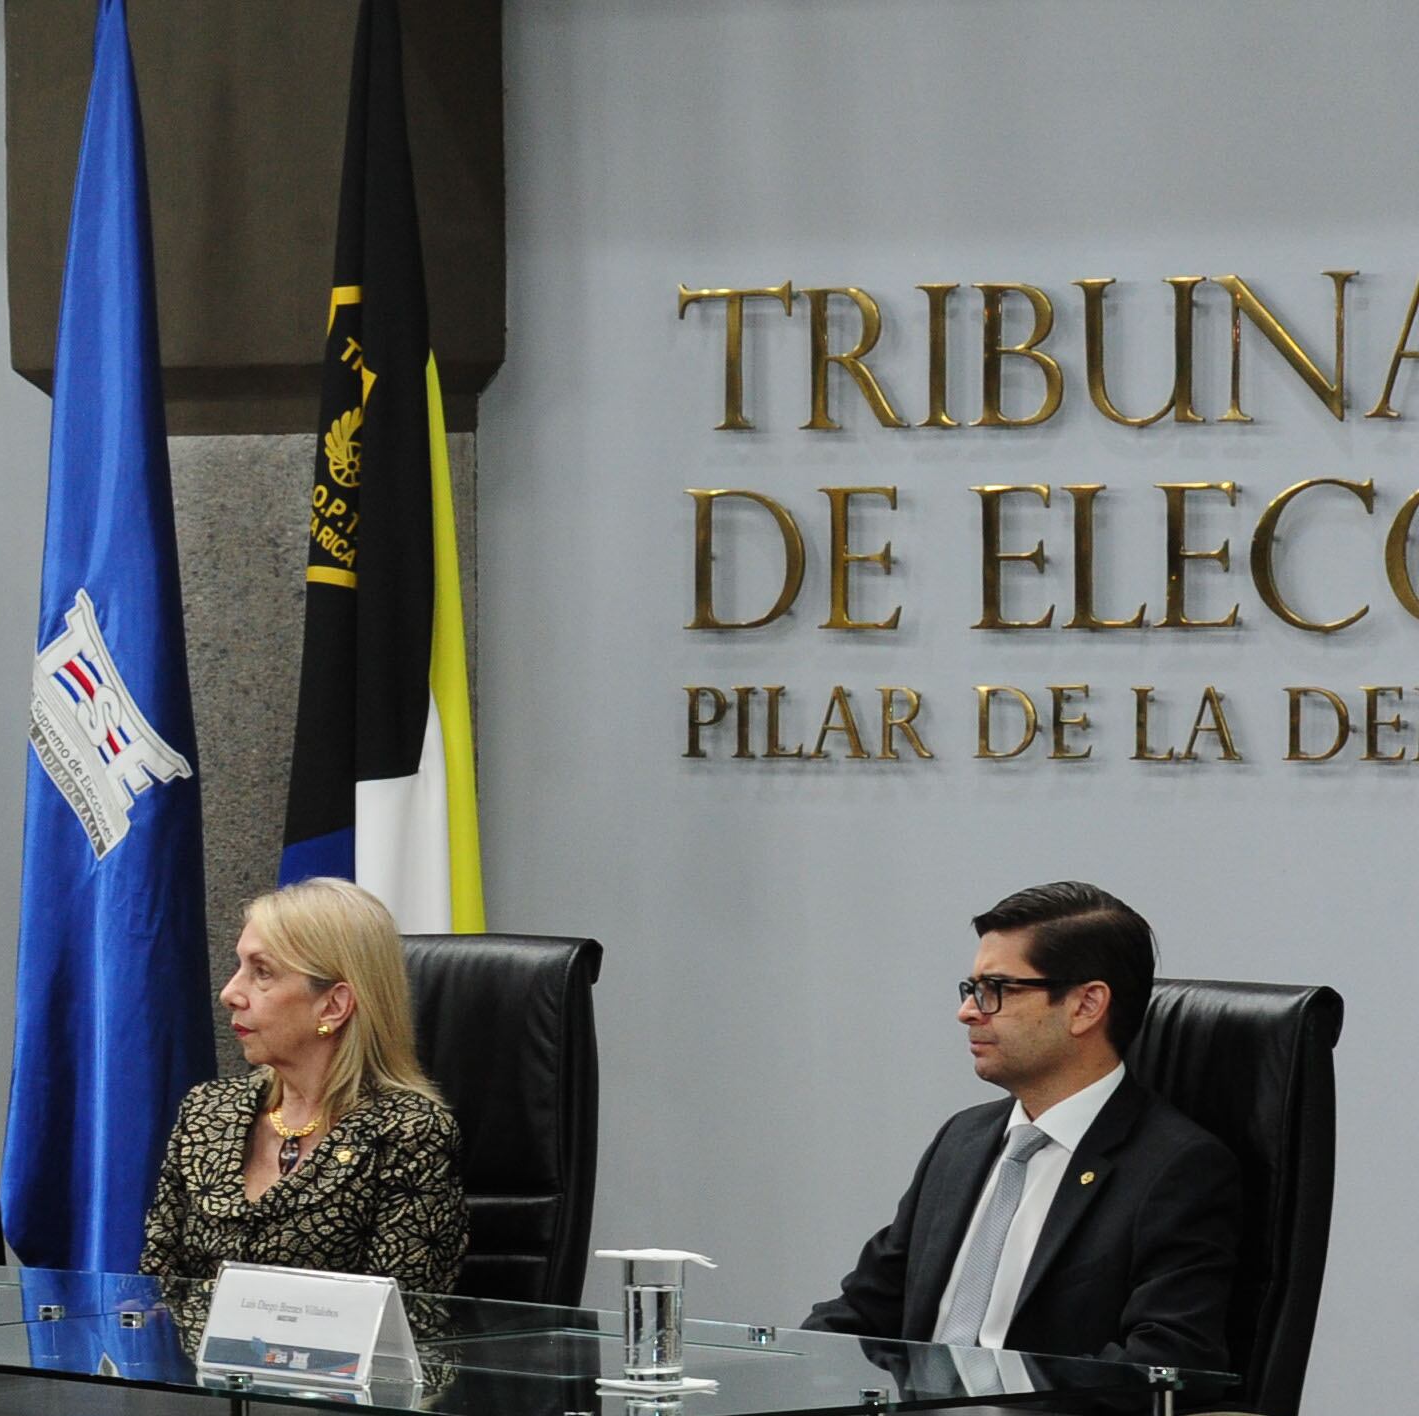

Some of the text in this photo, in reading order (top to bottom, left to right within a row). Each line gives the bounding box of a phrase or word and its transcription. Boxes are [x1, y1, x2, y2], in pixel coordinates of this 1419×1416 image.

[682, 477, 1419, 634] DE ELEC
[32, 699, 114, 843] Supremo de Elecciones
[681, 685, 1419, 761] PILAR DE LA DE
